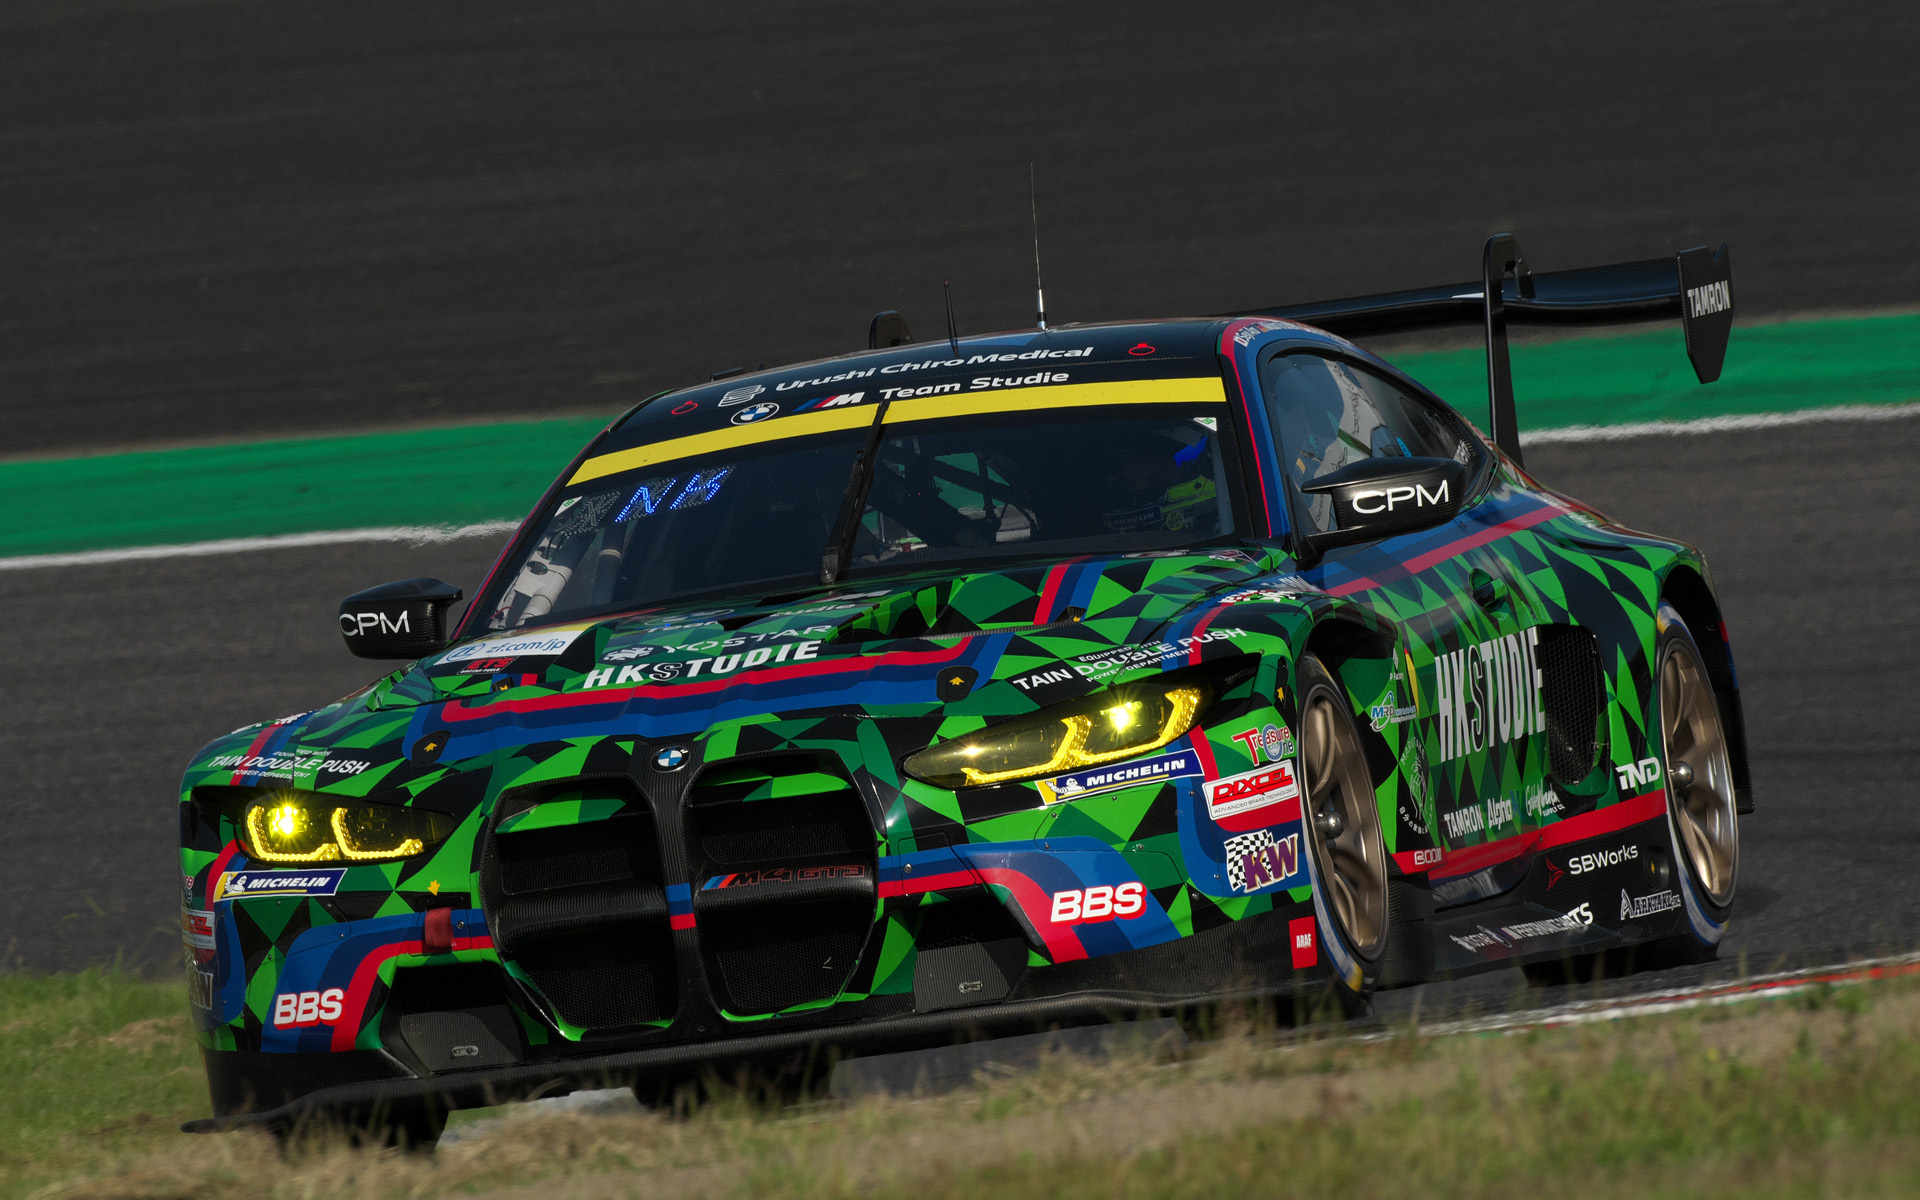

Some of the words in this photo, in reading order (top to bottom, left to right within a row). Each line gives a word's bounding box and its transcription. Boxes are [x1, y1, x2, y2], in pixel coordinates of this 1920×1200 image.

[1687, 280, 1731, 318] TAMRON
[775, 367, 876, 392] Urushi
[880, 358, 965, 375] Chiro
[967, 346, 1094, 365] Medical
[879, 382, 961, 400] Team
[969, 371, 1069, 390] Studie
[1352, 479, 1449, 514] CPM
[340, 610, 410, 636] CPM
[485, 639, 566, 653] zf.com/jp
[662, 624, 834, 653] YOSTAR
[1079, 645, 1132, 662] EQUIPPED
[582, 639, 822, 689] HKSTUDIE
[1012, 668, 1073, 690] TAIN
[1074, 642, 1177, 676] DOUBLE
[1178, 627, 1247, 647] PUSH
[1125, 648, 1194, 672] DEPARTMENT
[1434, 626, 1546, 763] HKSTUDIE
[1371, 704, 1395, 718] MRD
[1231, 726, 1290, 767] Treasure
[207, 756, 246, 768] TAIN
[243, 756, 322, 771] DOUBLE
[316, 759, 371, 774] PUSH
[1086, 759, 1186, 787] MICHELIN
[1212, 767, 1293, 806] DIXCEL
[1214, 801, 1248, 814] ADVANCED
[1248, 796, 1265, 805] BRAKE
[1266, 787, 1295, 800] TECHNOLOGY
[1443, 803, 1485, 838] TAMRON
[1241, 832, 1298, 893] KW
[1568, 844, 1639, 875] SBWorks
[247, 876, 331, 889] MICHELIN
[727, 867, 793, 888] M4
[797, 864, 865, 881] GT3
[1050, 881, 1144, 923] BBS
[1296, 933, 1312, 949] ARAF
[273, 988, 345, 1026] BBS
